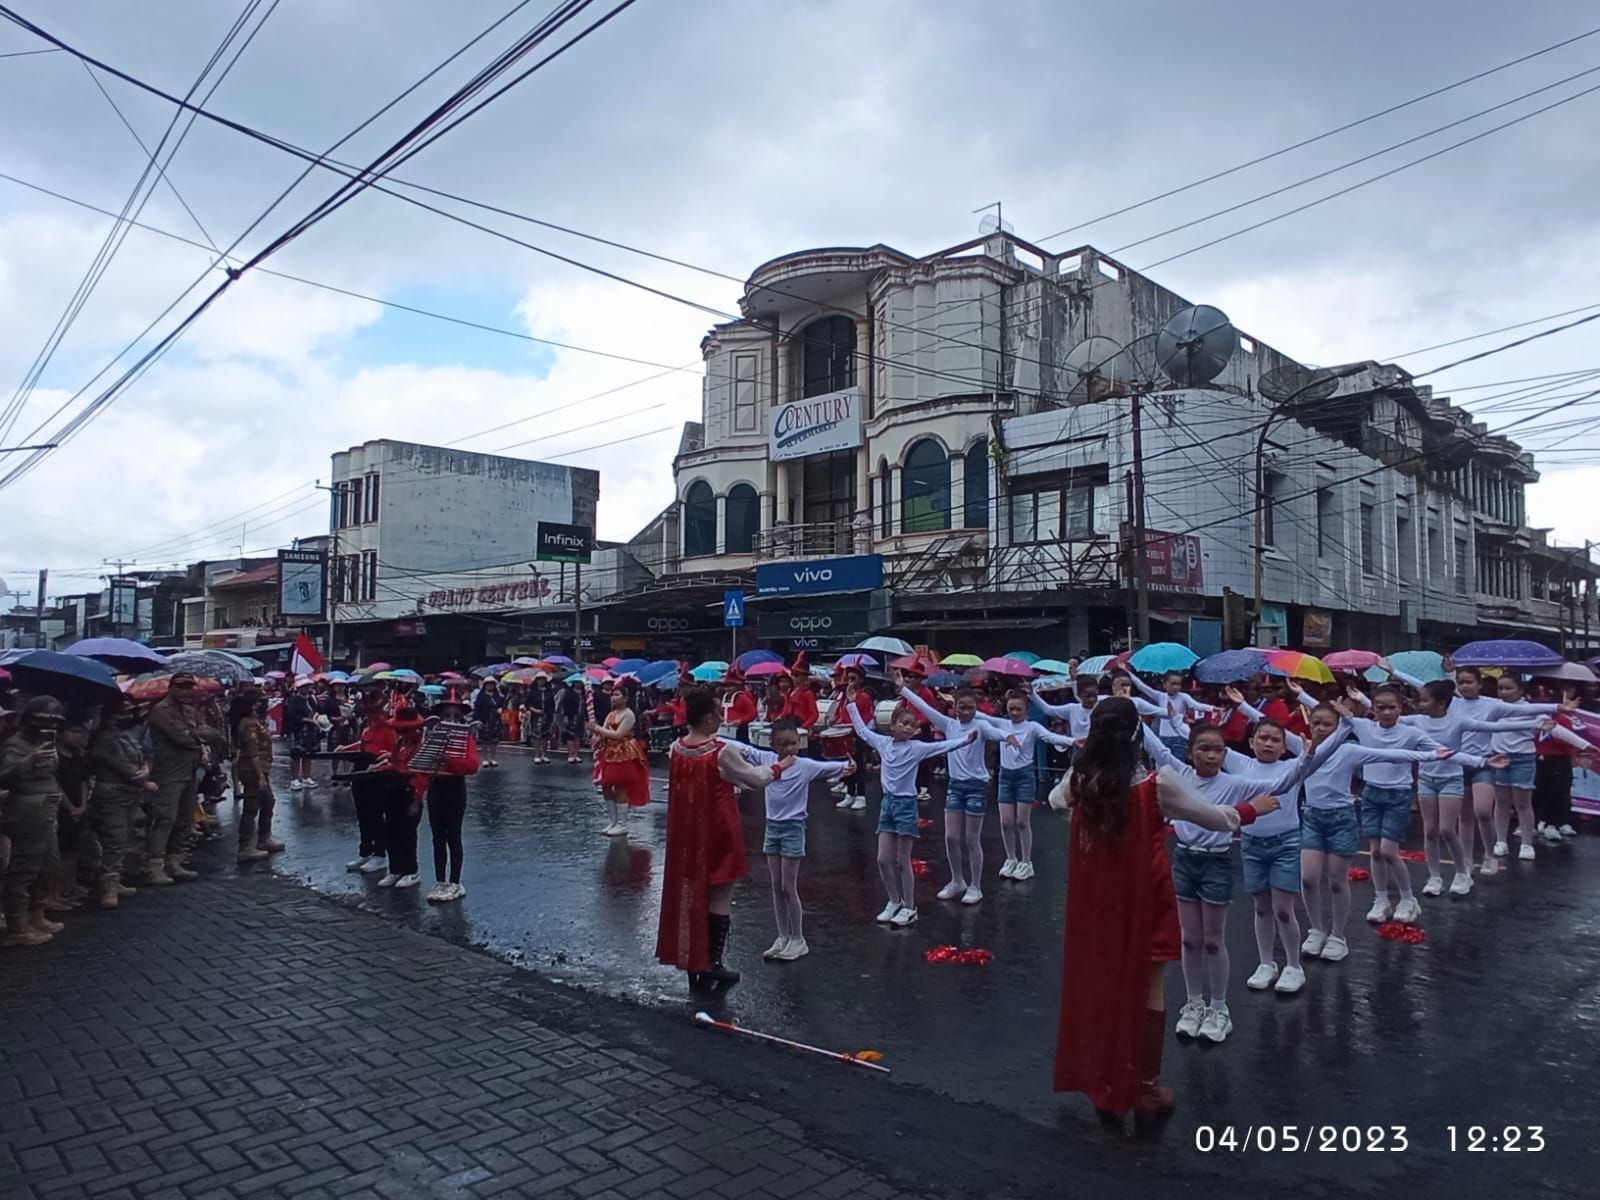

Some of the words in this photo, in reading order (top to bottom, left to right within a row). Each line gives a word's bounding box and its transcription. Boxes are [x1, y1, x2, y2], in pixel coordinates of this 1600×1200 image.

[774, 395, 852, 437] CENTURY
[544, 533, 584, 547] Infinix
[794, 567, 832, 582] vivo
[428, 587, 474, 607] GRAND
[477, 578, 551, 603] CENTRAL
[648, 617, 688, 631] oppo
[790, 617, 832, 632] oppo
[794, 636, 818, 647] vivo
